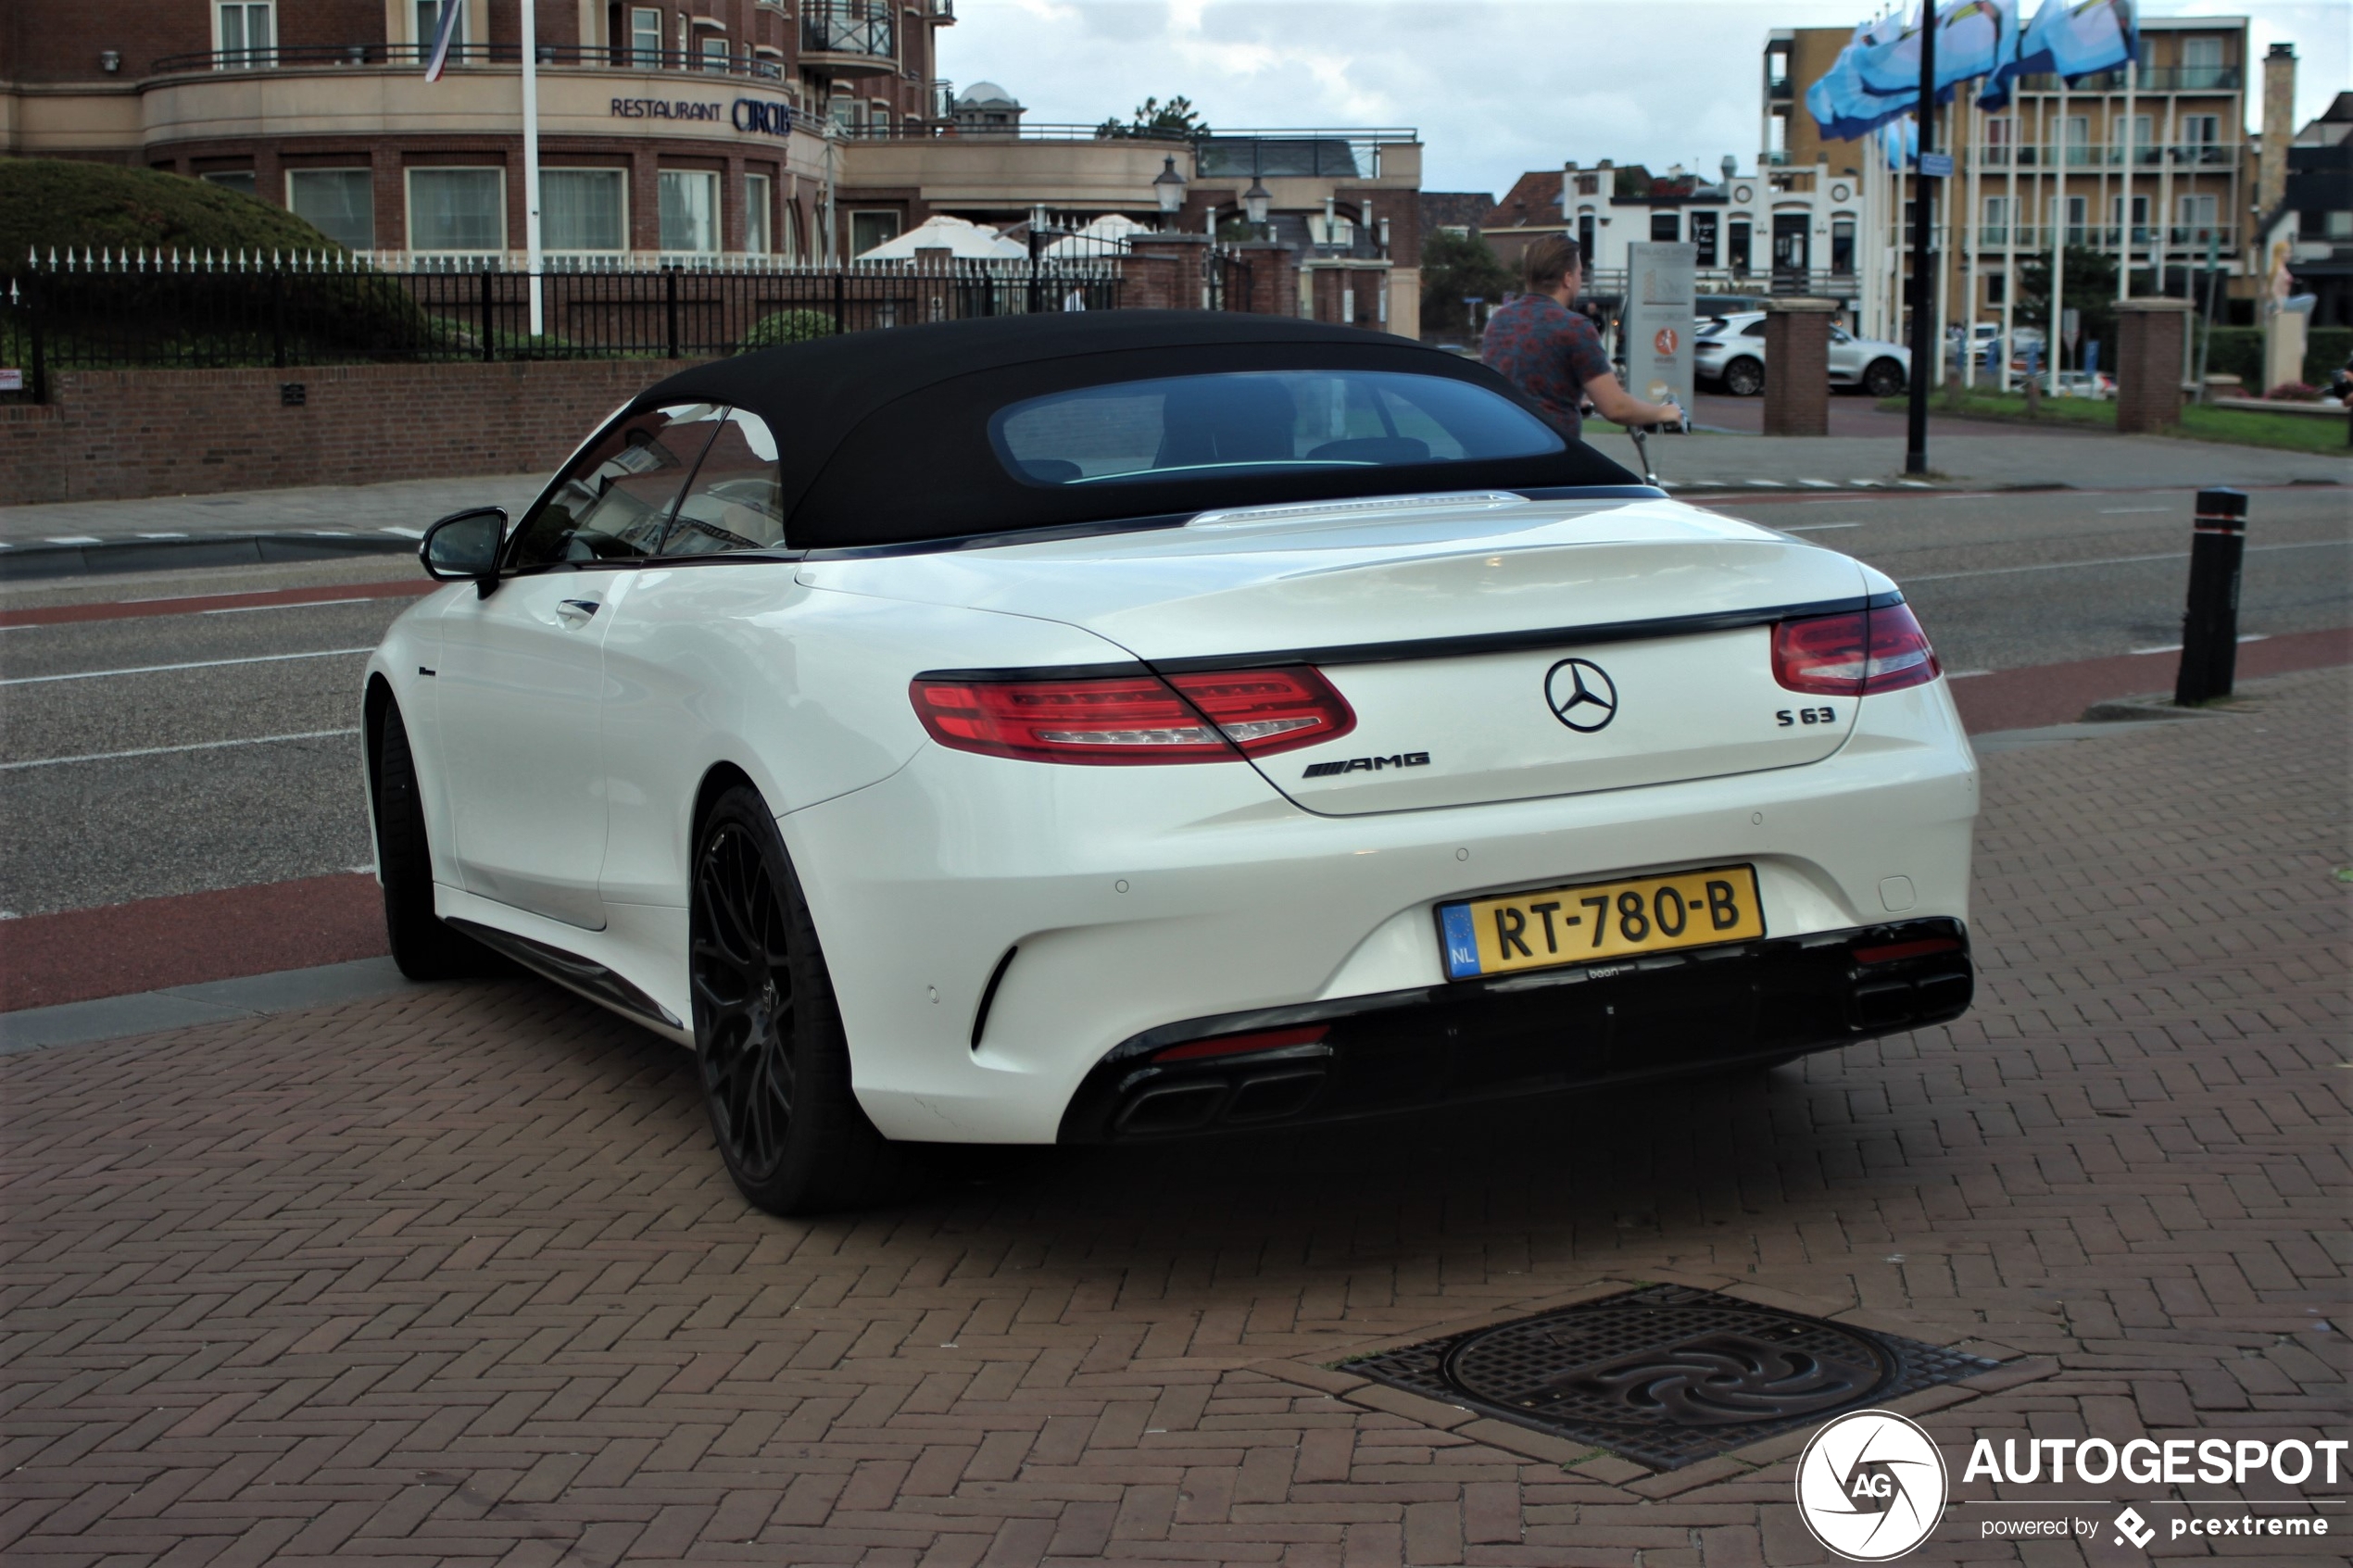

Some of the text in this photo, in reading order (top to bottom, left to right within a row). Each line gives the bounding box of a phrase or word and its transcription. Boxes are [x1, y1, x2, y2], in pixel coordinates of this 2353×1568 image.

[611, 98, 723, 121] RESTAURANT
[1776, 707, 1836, 727] S 63
[1343, 751, 1431, 774] AMG
[1494, 880, 1740, 960] RT-780-B
[1452, 947, 1476, 965] NL
